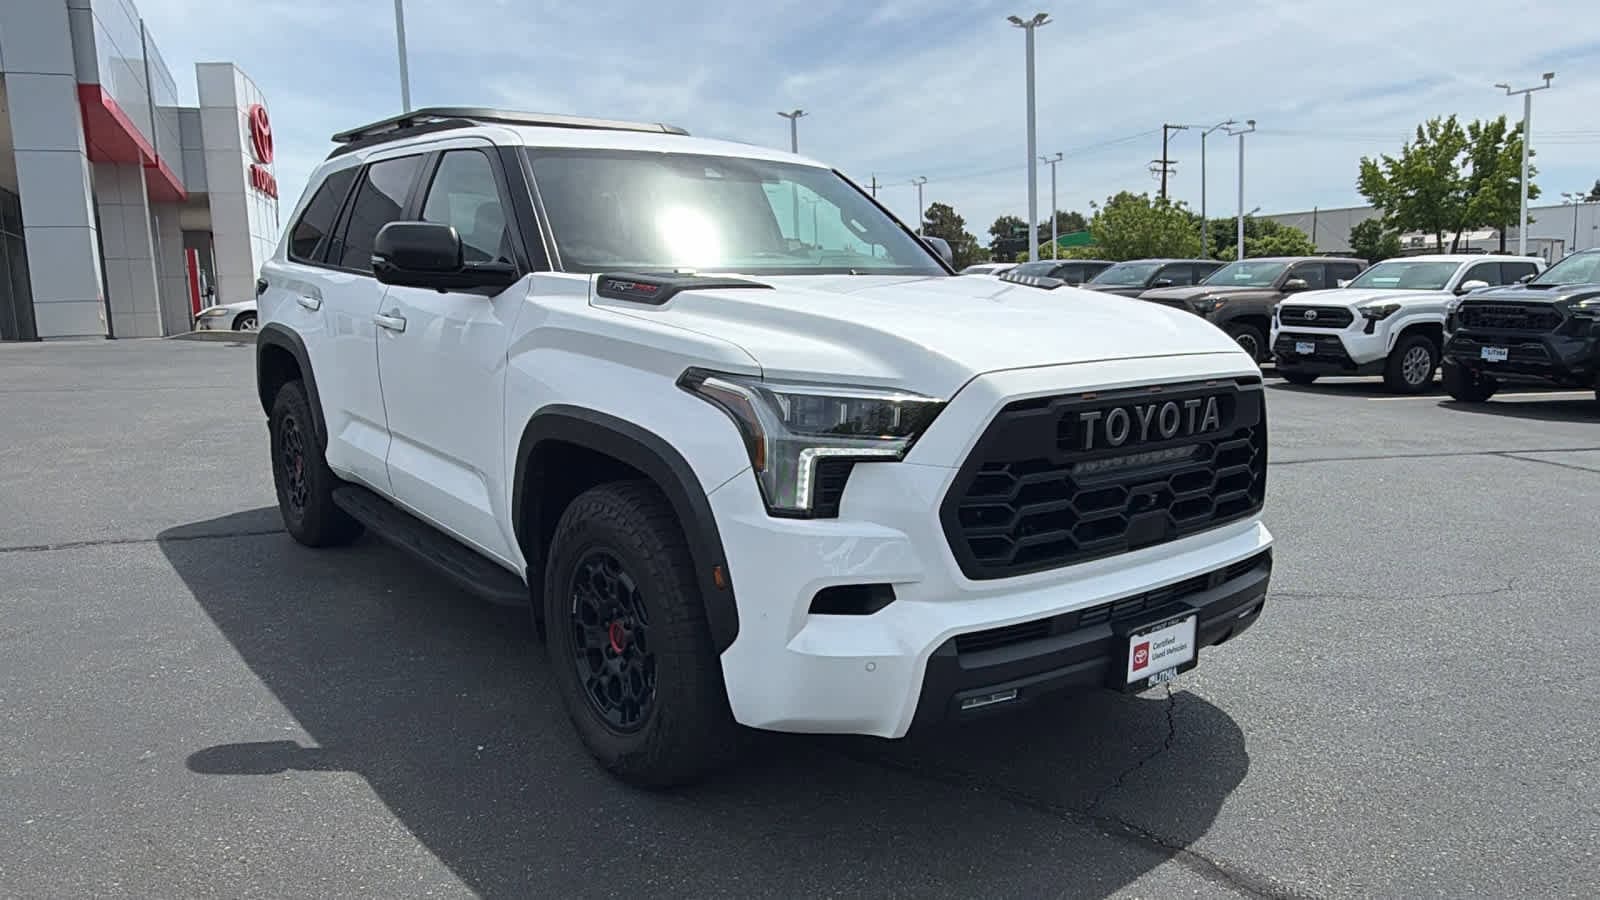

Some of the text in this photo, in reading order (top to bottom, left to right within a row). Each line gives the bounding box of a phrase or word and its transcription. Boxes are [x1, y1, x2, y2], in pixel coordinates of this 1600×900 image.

[607, 280, 633, 291] TRD
[1080, 396, 1220, 449] TOYOTA
[1152, 636, 1176, 651] Certified
